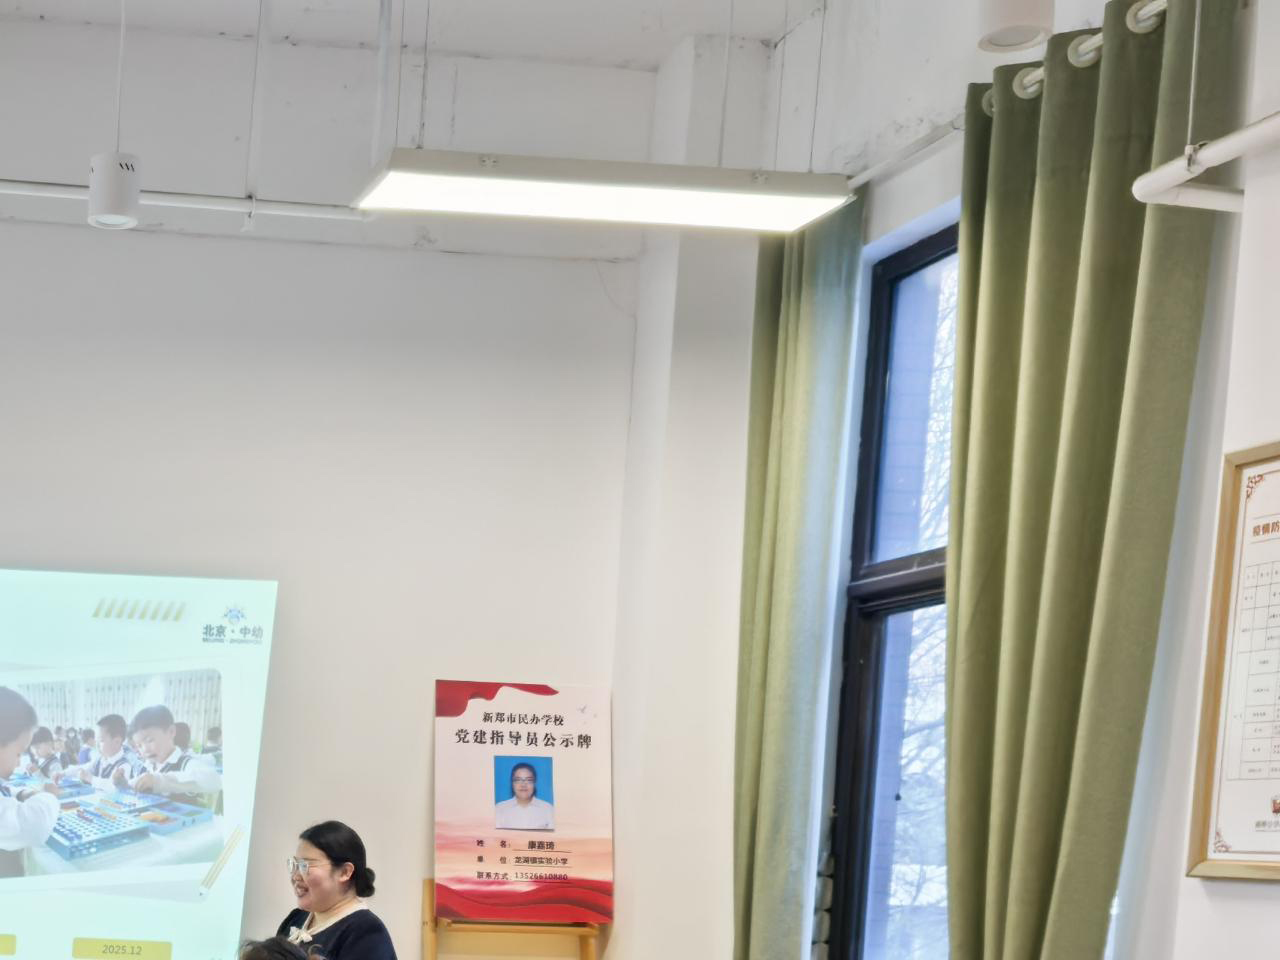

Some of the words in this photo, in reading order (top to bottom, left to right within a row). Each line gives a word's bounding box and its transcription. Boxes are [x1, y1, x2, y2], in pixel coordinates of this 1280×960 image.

[482, 712, 564, 726] 新郑市民办学校
[455, 728, 592, 749] 党建指导员公示牌
[102, 943, 143, 956] 2025.12
